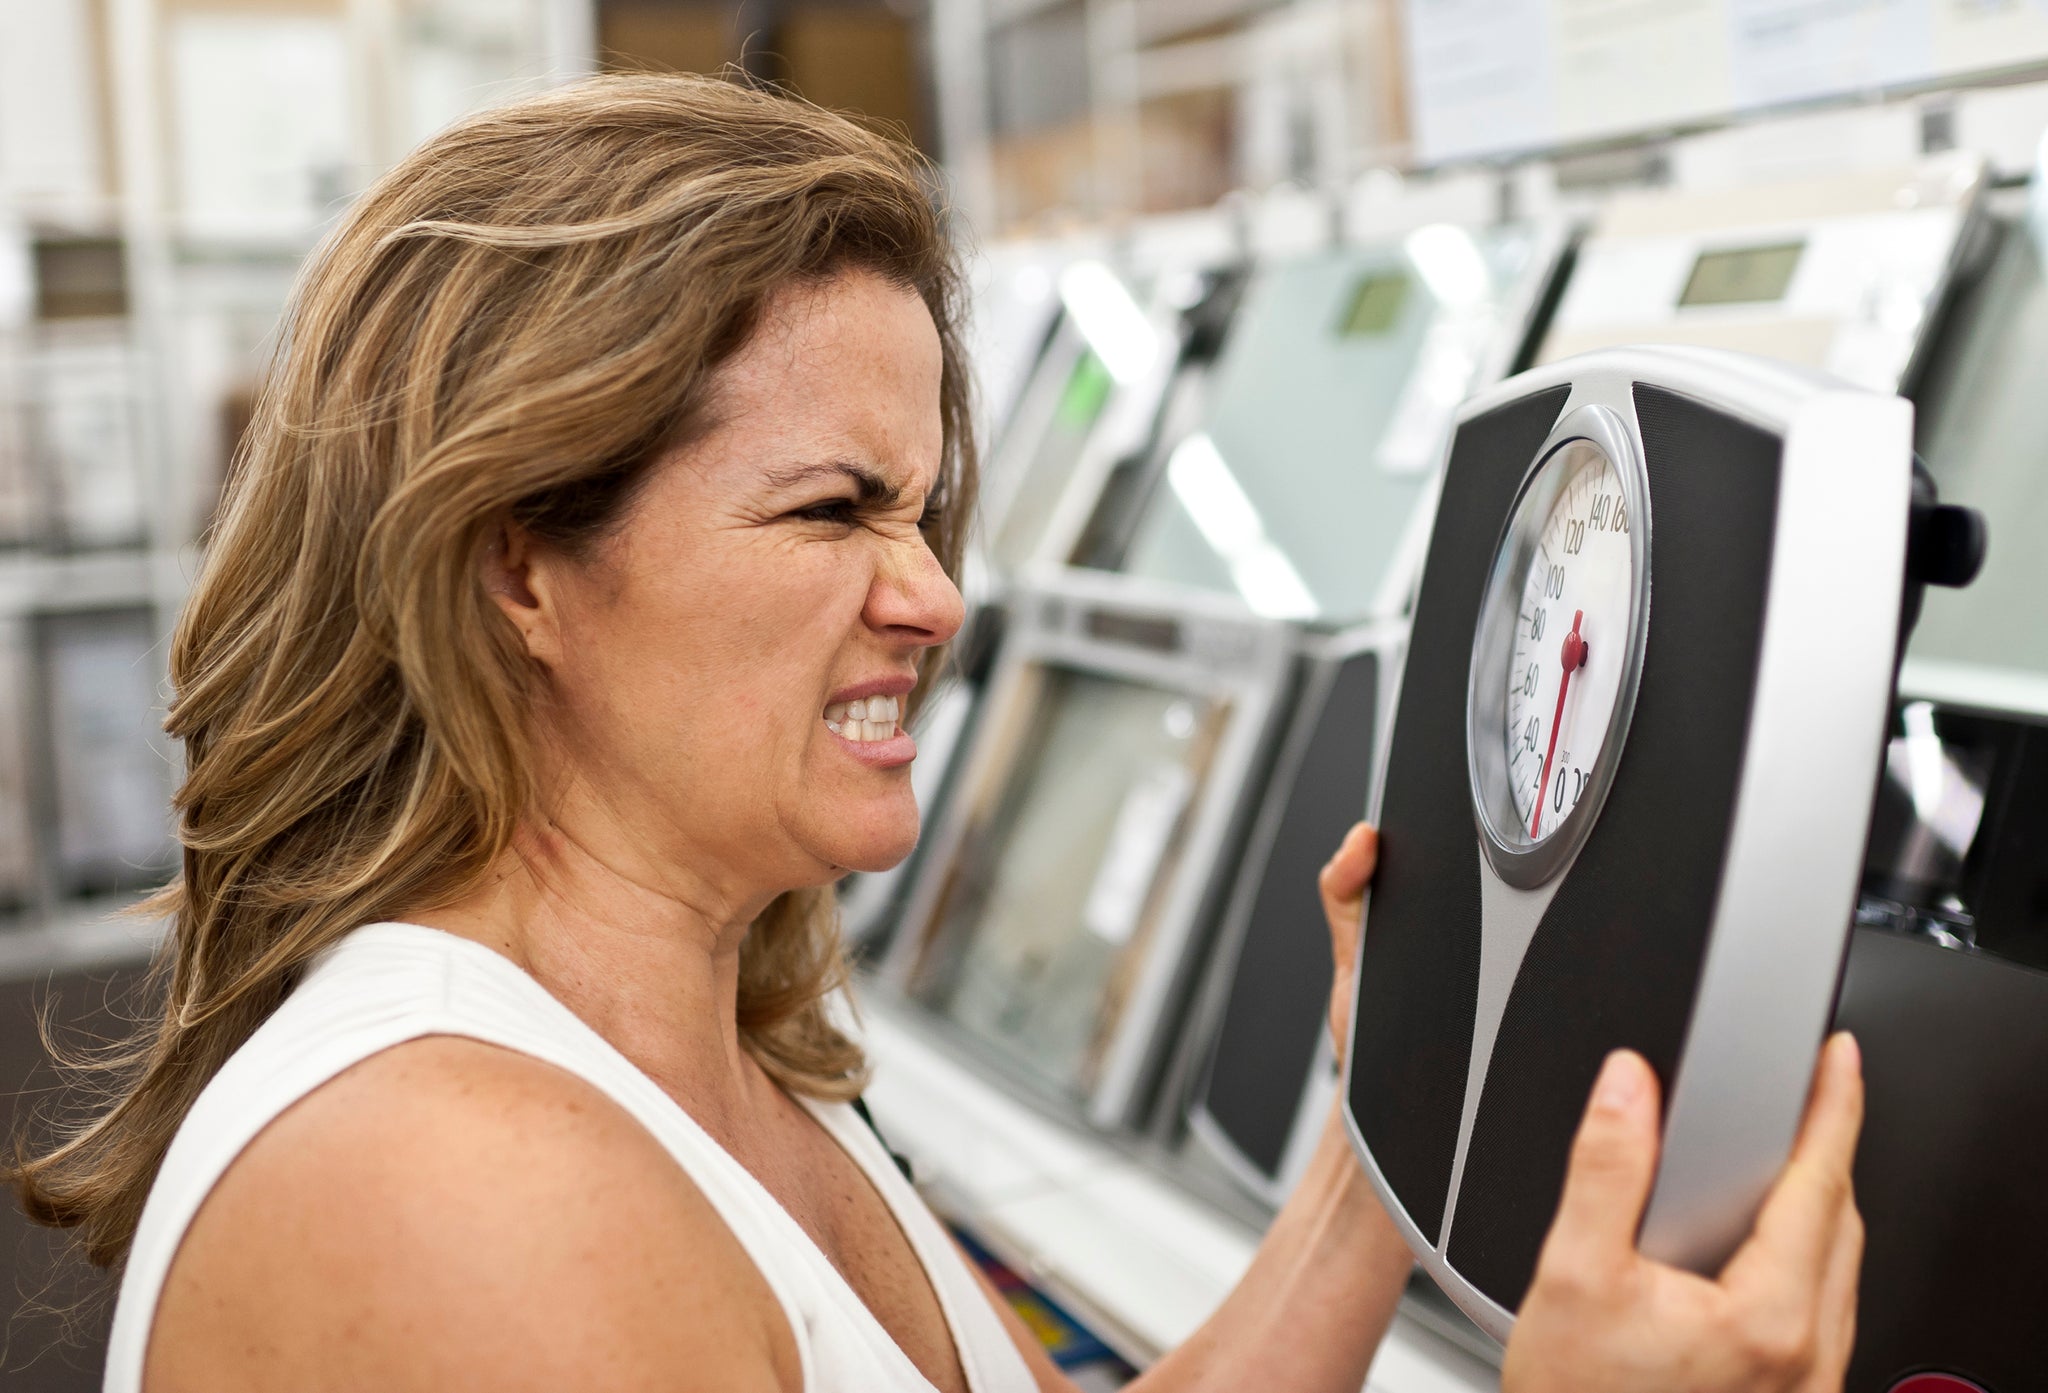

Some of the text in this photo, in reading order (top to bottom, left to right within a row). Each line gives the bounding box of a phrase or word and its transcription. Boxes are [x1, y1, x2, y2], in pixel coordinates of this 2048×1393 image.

[1588, 494, 1611, 530] 140
[1563, 519, 1585, 555] 120
[1544, 565, 1564, 600] 100
[1531, 607, 1546, 642] 80
[1524, 663, 1539, 698] 60
[1524, 716, 1540, 752] 40
[1554, 767, 1566, 813] 0
